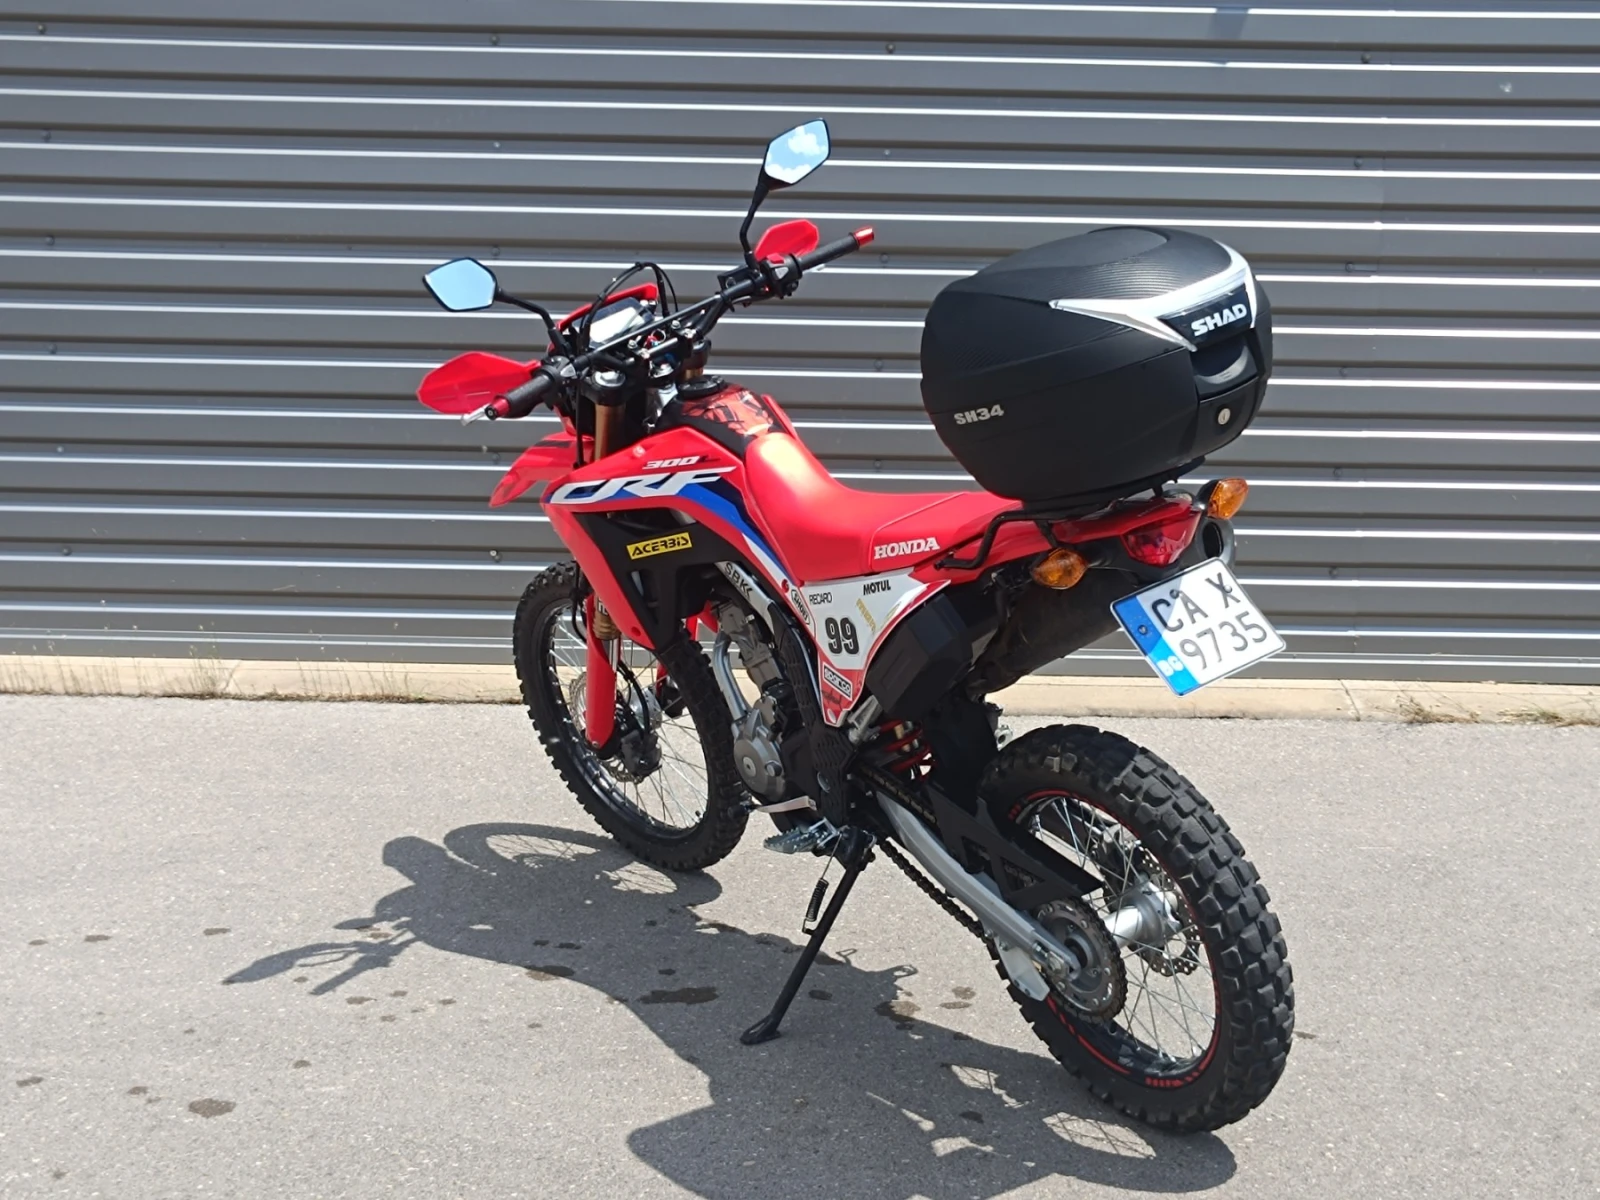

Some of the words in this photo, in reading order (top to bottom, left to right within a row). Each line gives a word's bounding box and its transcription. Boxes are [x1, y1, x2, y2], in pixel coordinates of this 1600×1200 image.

[1191, 303, 1248, 337] SHAD
[953, 404, 1005, 425] SH34
[550, 466, 737, 504] CRF
[631, 534, 690, 557] ACERBIS
[874, 537, 940, 560] HONDA
[809, 592, 833, 605] RECARO
[863, 580, 891, 596] MOTUL
[1151, 590, 1209, 632] CA
[1204, 572, 1241, 609] X
[825, 617, 860, 655] 99
[1179, 610, 1268, 670] 9735
